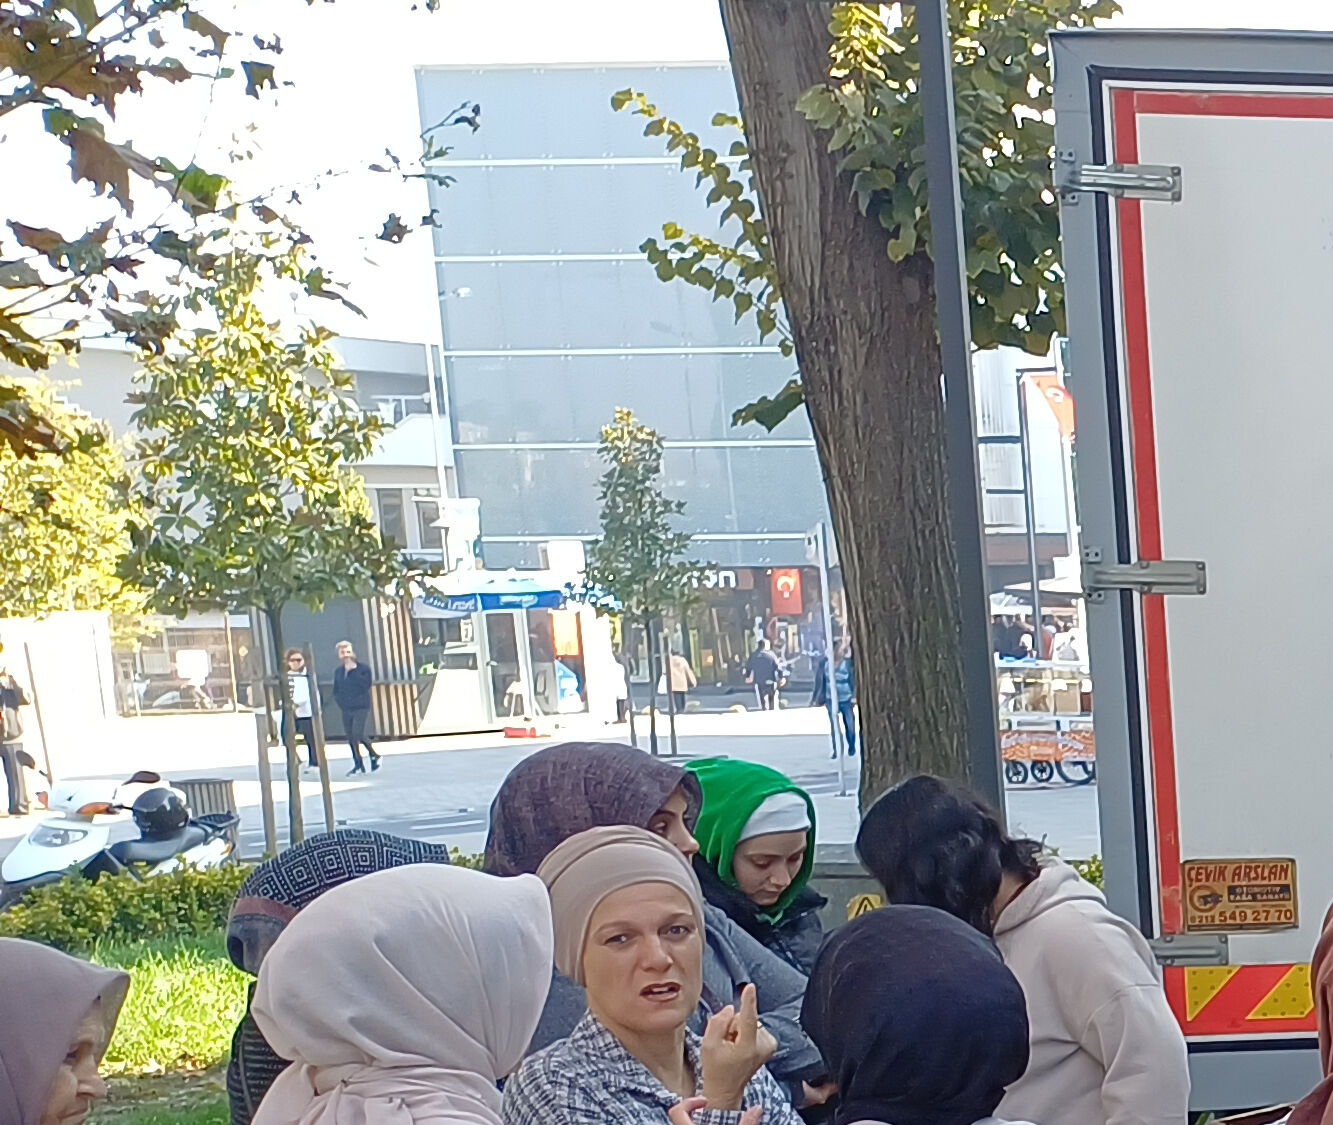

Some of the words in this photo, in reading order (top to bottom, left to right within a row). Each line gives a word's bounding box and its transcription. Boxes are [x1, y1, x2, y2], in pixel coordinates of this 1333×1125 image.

[1231, 863, 1290, 883] ARSLAN
[1218, 910, 1248, 923] 549
[1251, 910, 1271, 922] 27
[1275, 908, 1293, 921] 70
